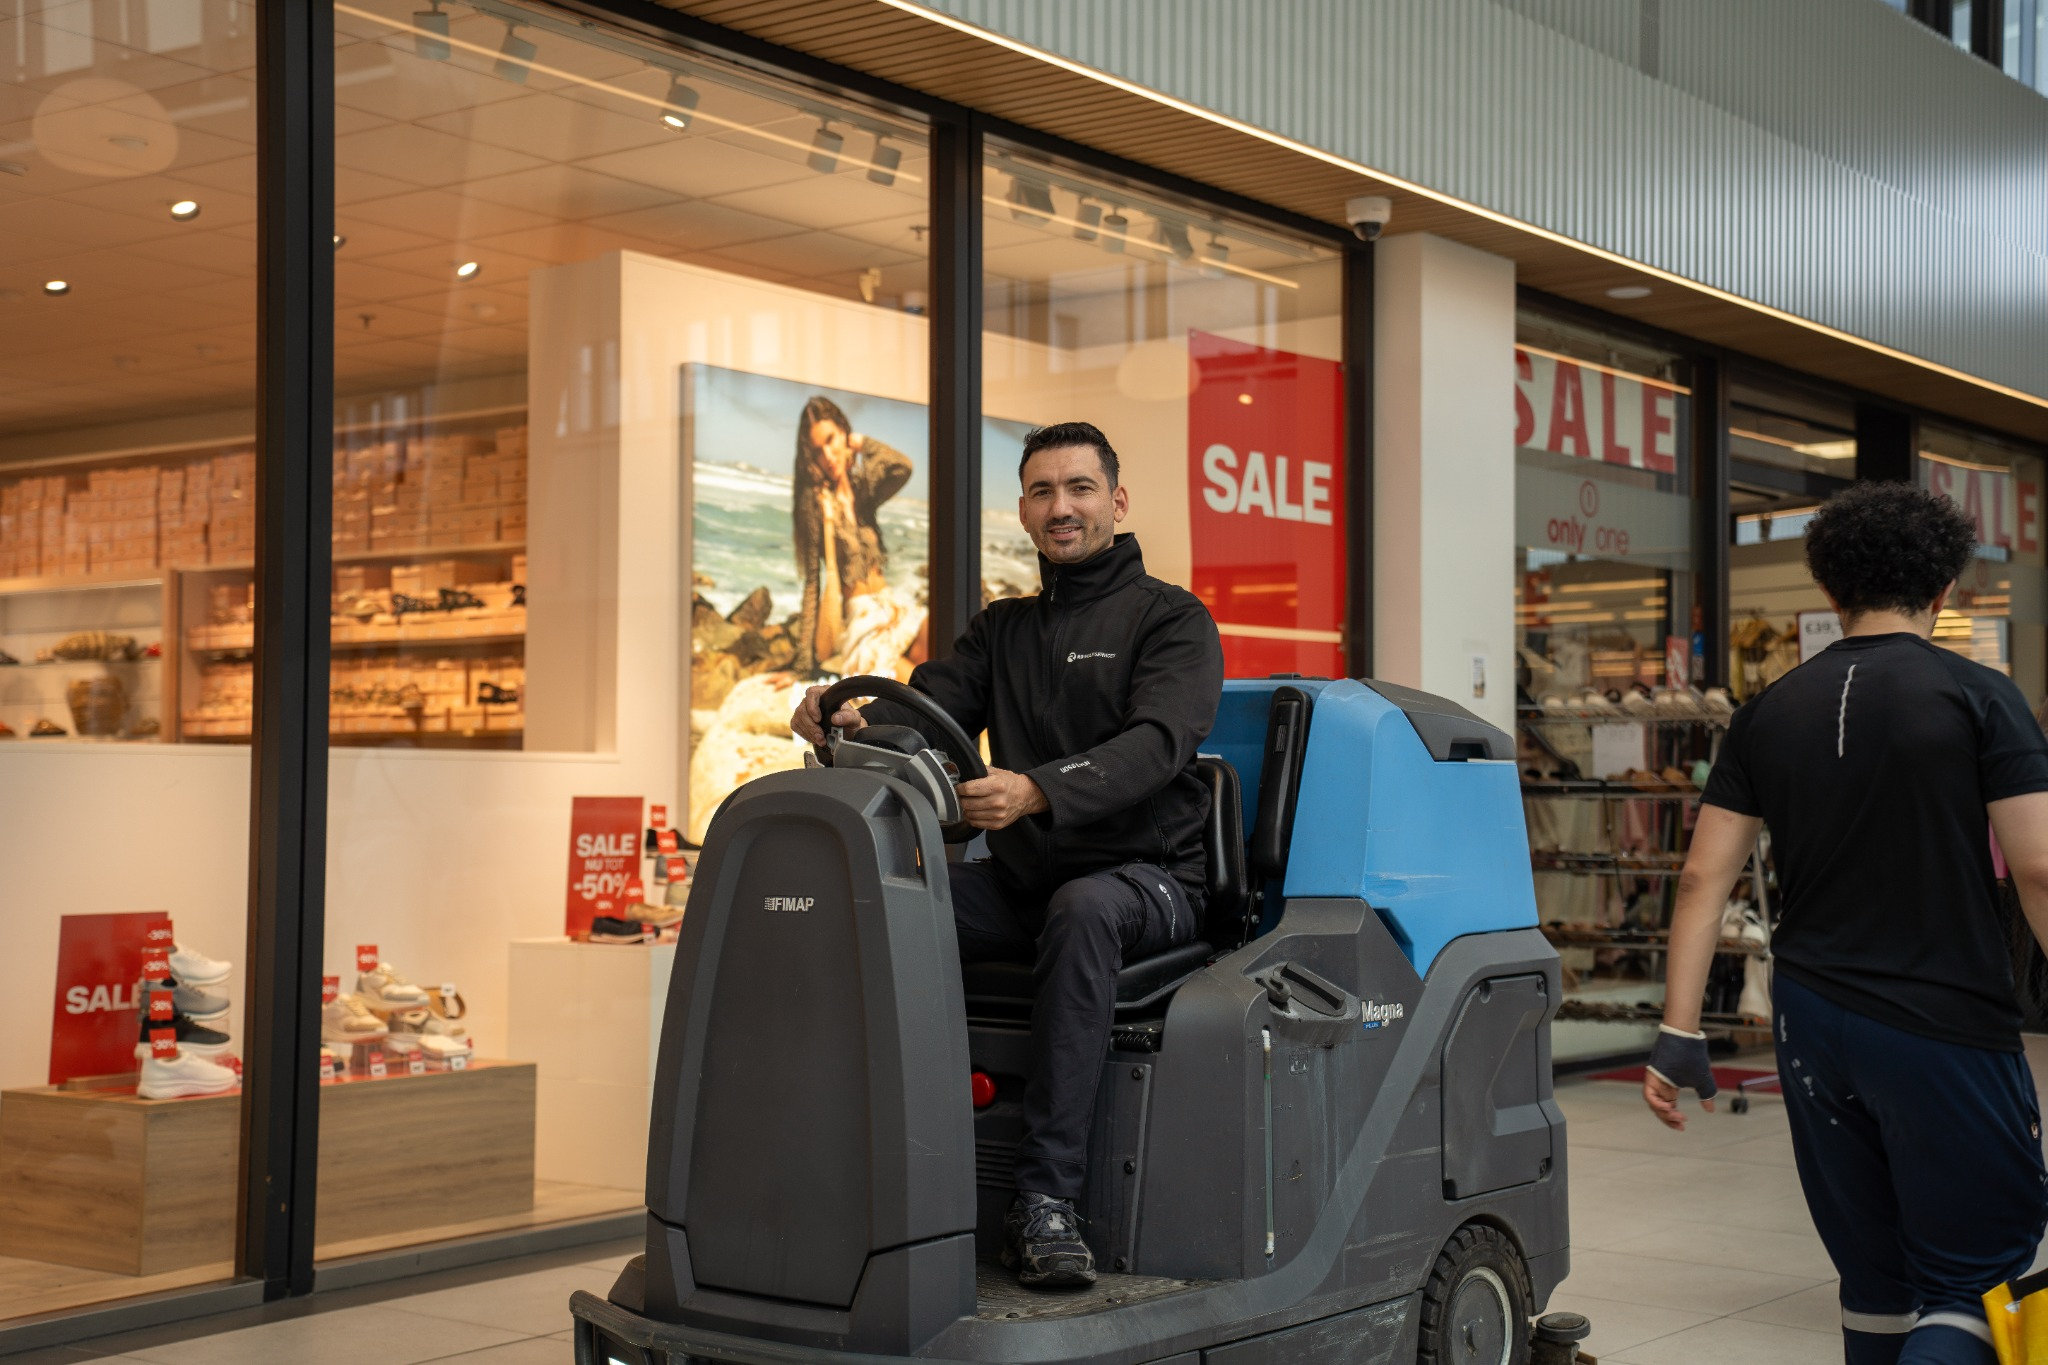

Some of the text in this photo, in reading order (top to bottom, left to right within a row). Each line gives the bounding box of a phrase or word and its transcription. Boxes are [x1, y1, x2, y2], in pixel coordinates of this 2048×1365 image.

[1202, 443, 1333, 526] SALE
[1547, 515, 1630, 555] only one
[576, 833, 636, 858] SALE
[585, 858, 625, 871] NU TOT
[774, 897, 815, 912] FIMAP
[1361, 999, 1404, 1027] Magna
